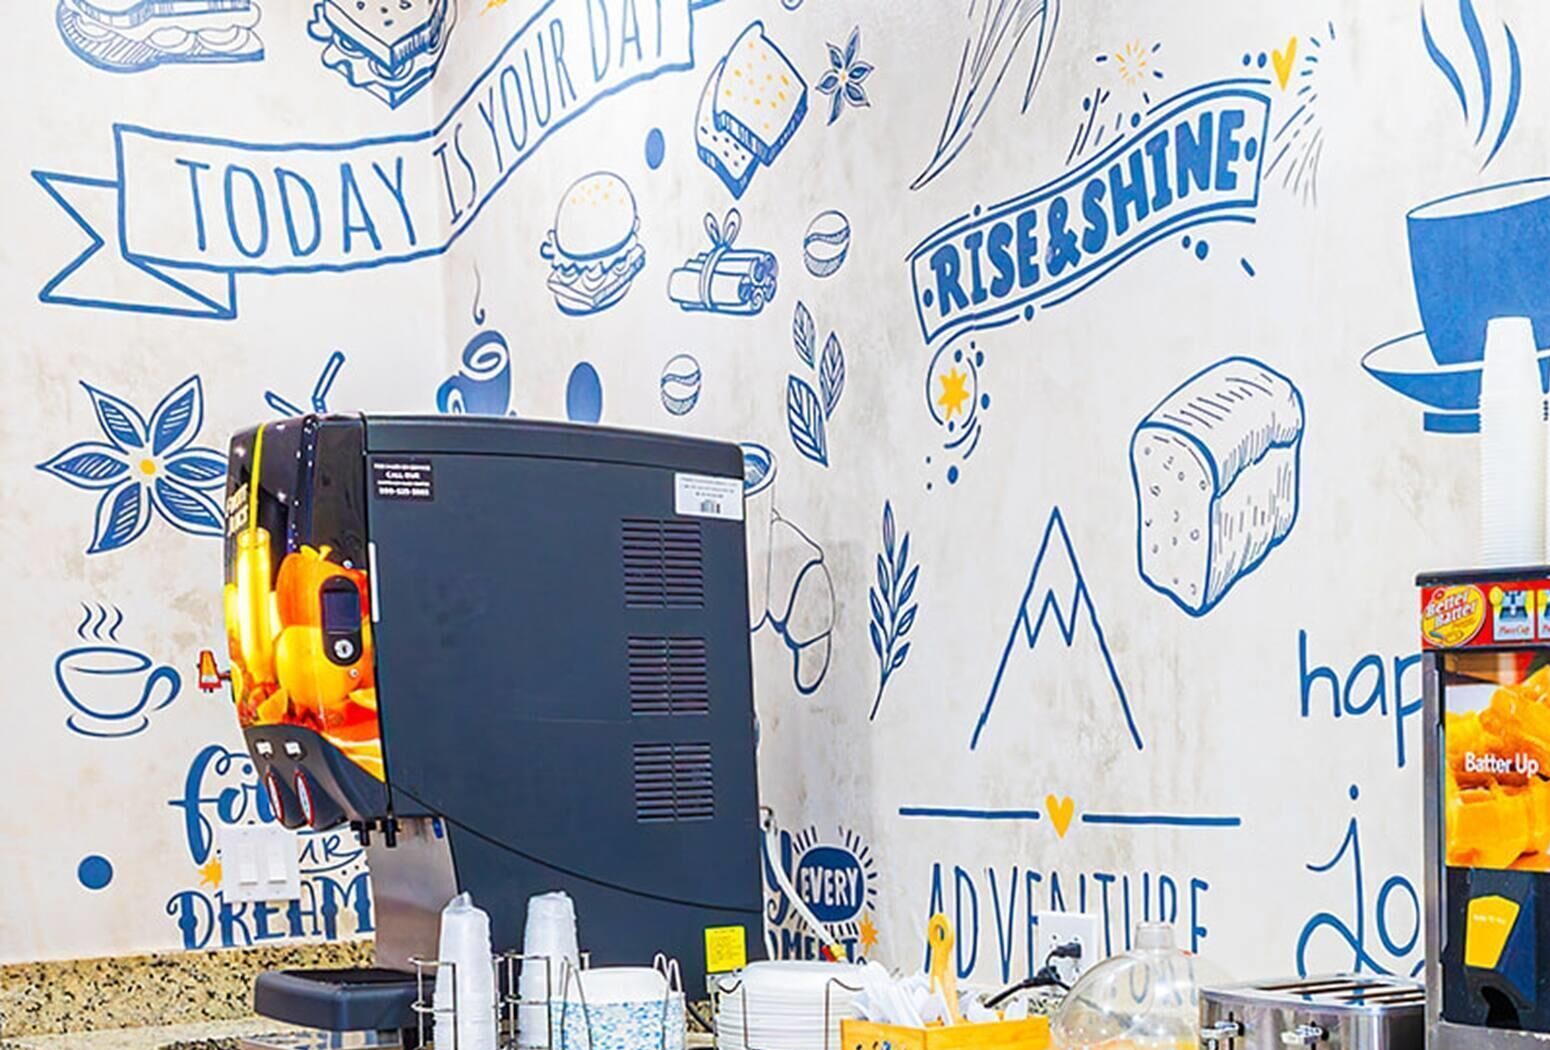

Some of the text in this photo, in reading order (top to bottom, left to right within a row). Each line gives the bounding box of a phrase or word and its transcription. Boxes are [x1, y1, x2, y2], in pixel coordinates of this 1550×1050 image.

[174, 156, 417, 259] TODAY
[432, 122, 477, 225] IS
[477, 17, 578, 174] YOUR
[1464, 751, 1540, 778] Batter Up
[800, 865, 859, 908] EVERY
